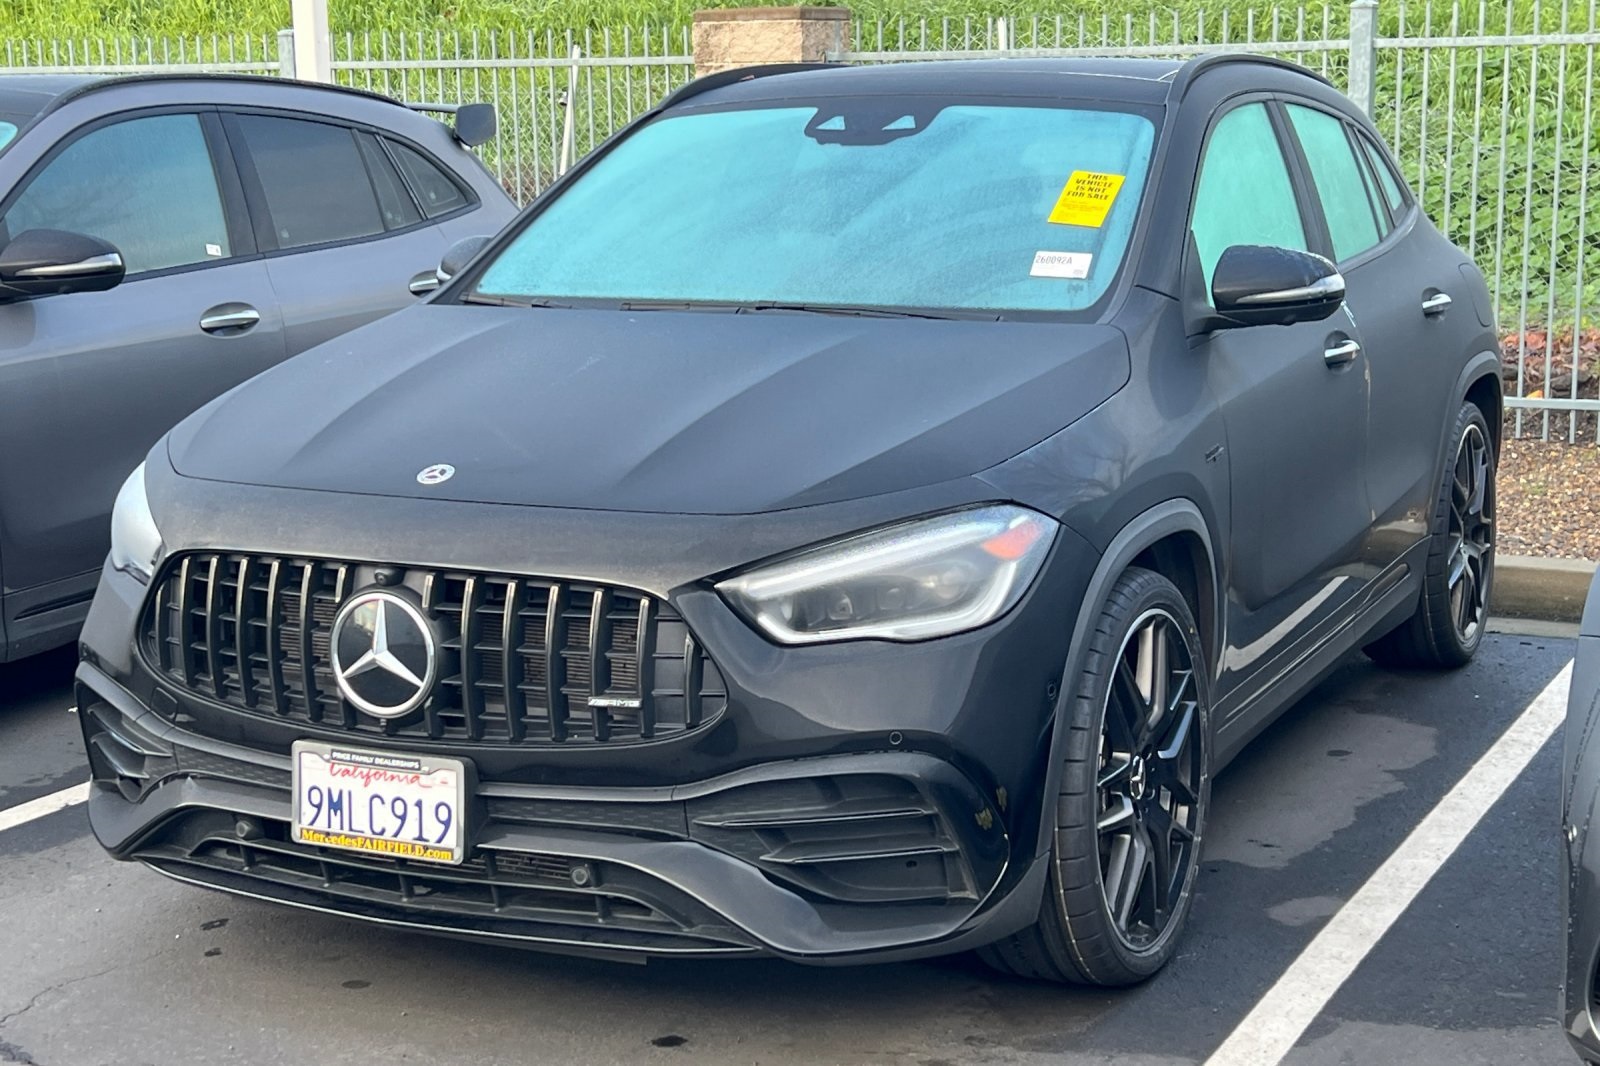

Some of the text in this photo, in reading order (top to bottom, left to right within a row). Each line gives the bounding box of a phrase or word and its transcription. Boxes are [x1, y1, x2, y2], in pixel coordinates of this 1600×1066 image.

[1087, 186, 1107, 194] NOT
[1035, 255, 1072, 264] 260092A
[332, 751, 420, 769] PRICE FAMILY DEALERSHIPS
[329, 762, 432, 788] California
[307, 785, 452, 844] 9MLC919
